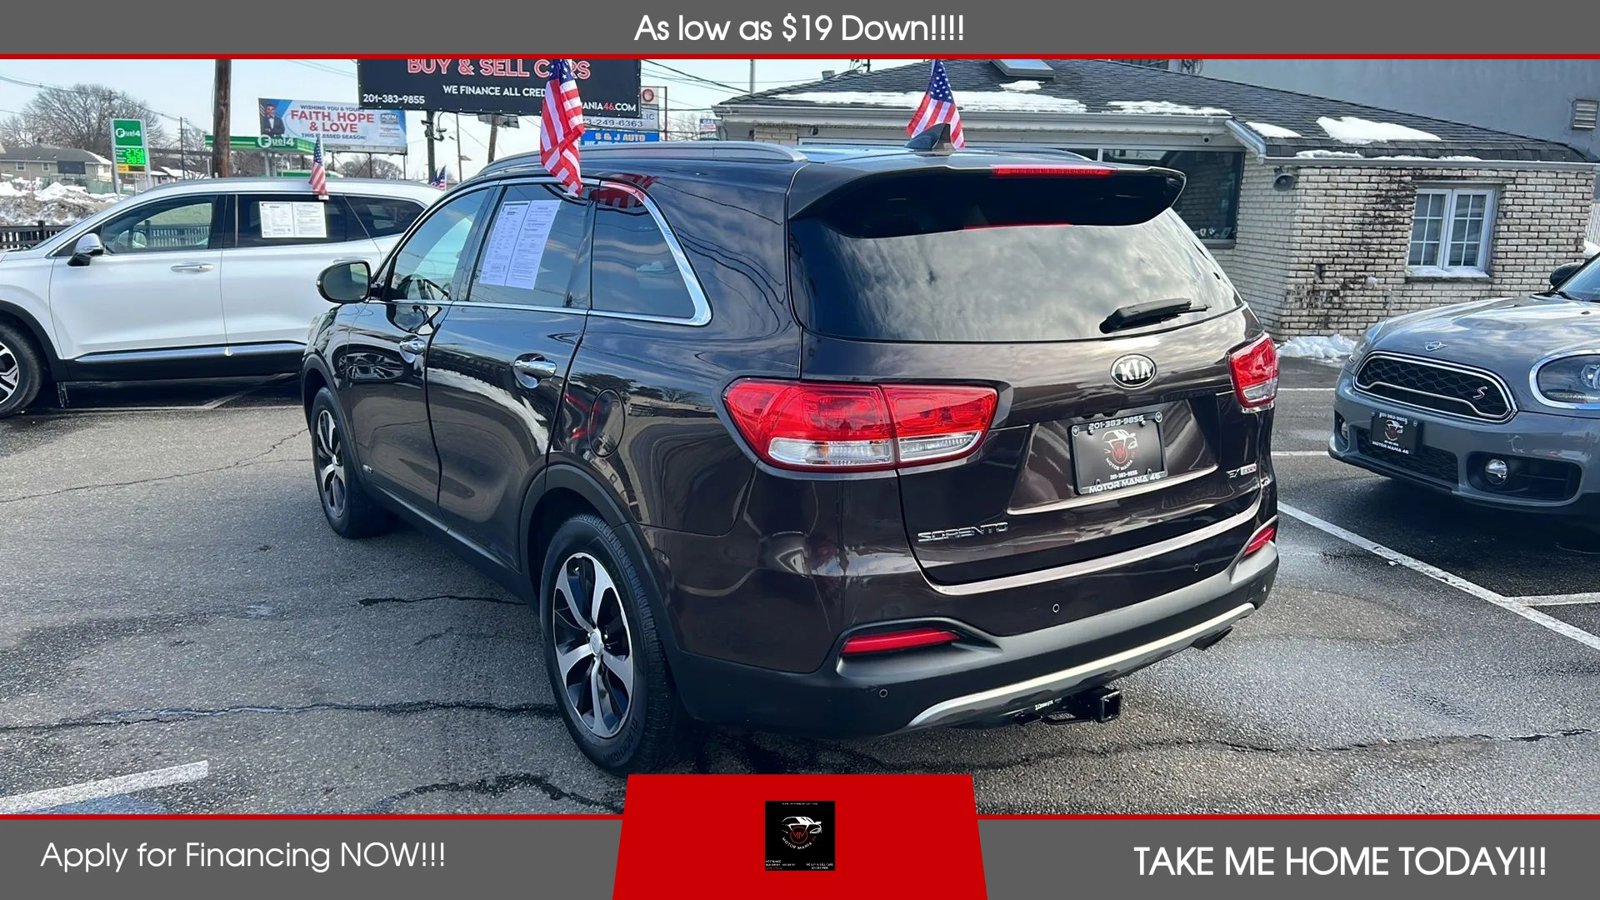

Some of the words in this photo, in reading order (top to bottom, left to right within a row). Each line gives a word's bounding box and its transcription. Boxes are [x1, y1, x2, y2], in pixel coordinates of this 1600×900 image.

[407, 59, 451, 75] BUY
[457, 59, 475, 76] &
[479, 59, 530, 77] SELL
[533, 59, 591, 80] CRS
[442, 85, 458, 95] WE
[460, 85, 501, 96] FINANCE
[502, 87, 521, 97] ALL
[522, 87, 546, 97] CRED
[362, 93, 426, 105] 201-383-9855
[580, 101, 637, 112] ANIA46.COM
[337, 111, 375, 123] HOPE
[309, 121, 319, 132] &
[322, 122, 358, 133] LOVE
[622, 133, 646, 142] AUTO
[1118, 359, 1152, 382] KIA
[1088, 481, 1121, 494] MOTOR
[1121, 474, 1149, 488] MANIA
[917, 521, 1009, 542] SORENTO
